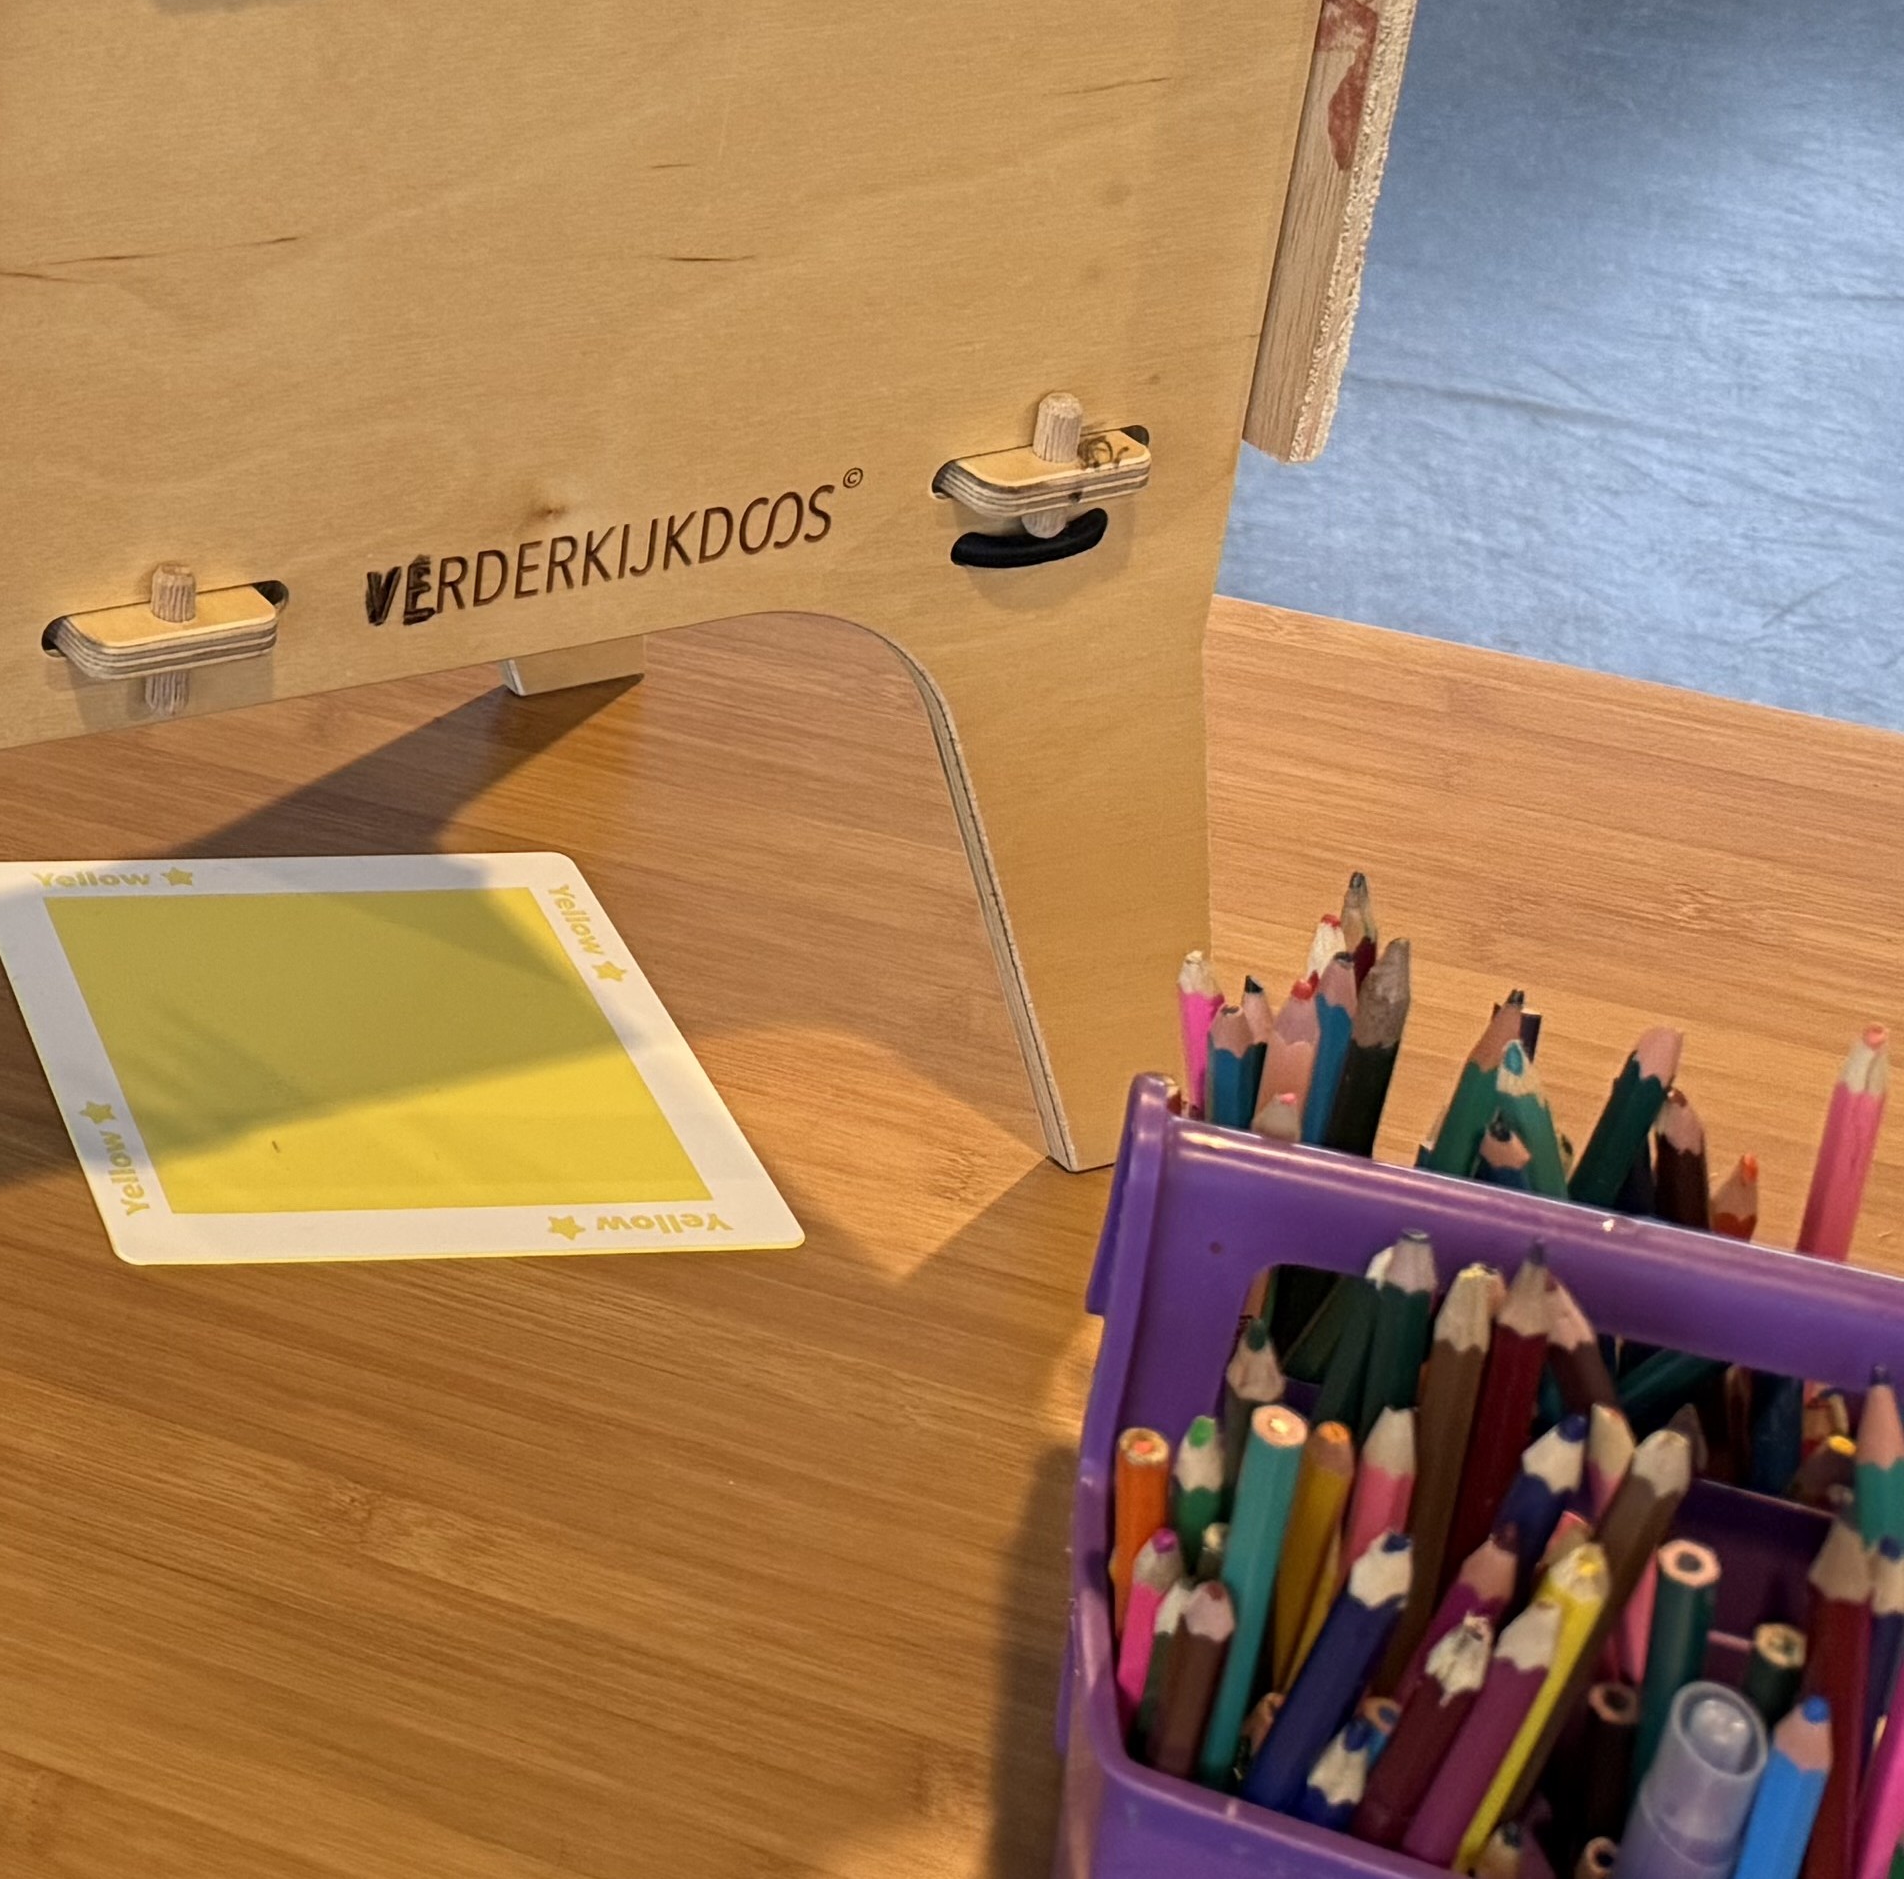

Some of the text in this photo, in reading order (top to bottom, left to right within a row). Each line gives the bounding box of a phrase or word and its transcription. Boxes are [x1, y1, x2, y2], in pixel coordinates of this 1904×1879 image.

[34, 869, 150, 889] Yellow
[547, 883, 605, 956] Yellow
[107, 1129, 150, 1218] Yellow
[596, 1211, 733, 1234] Yellow
